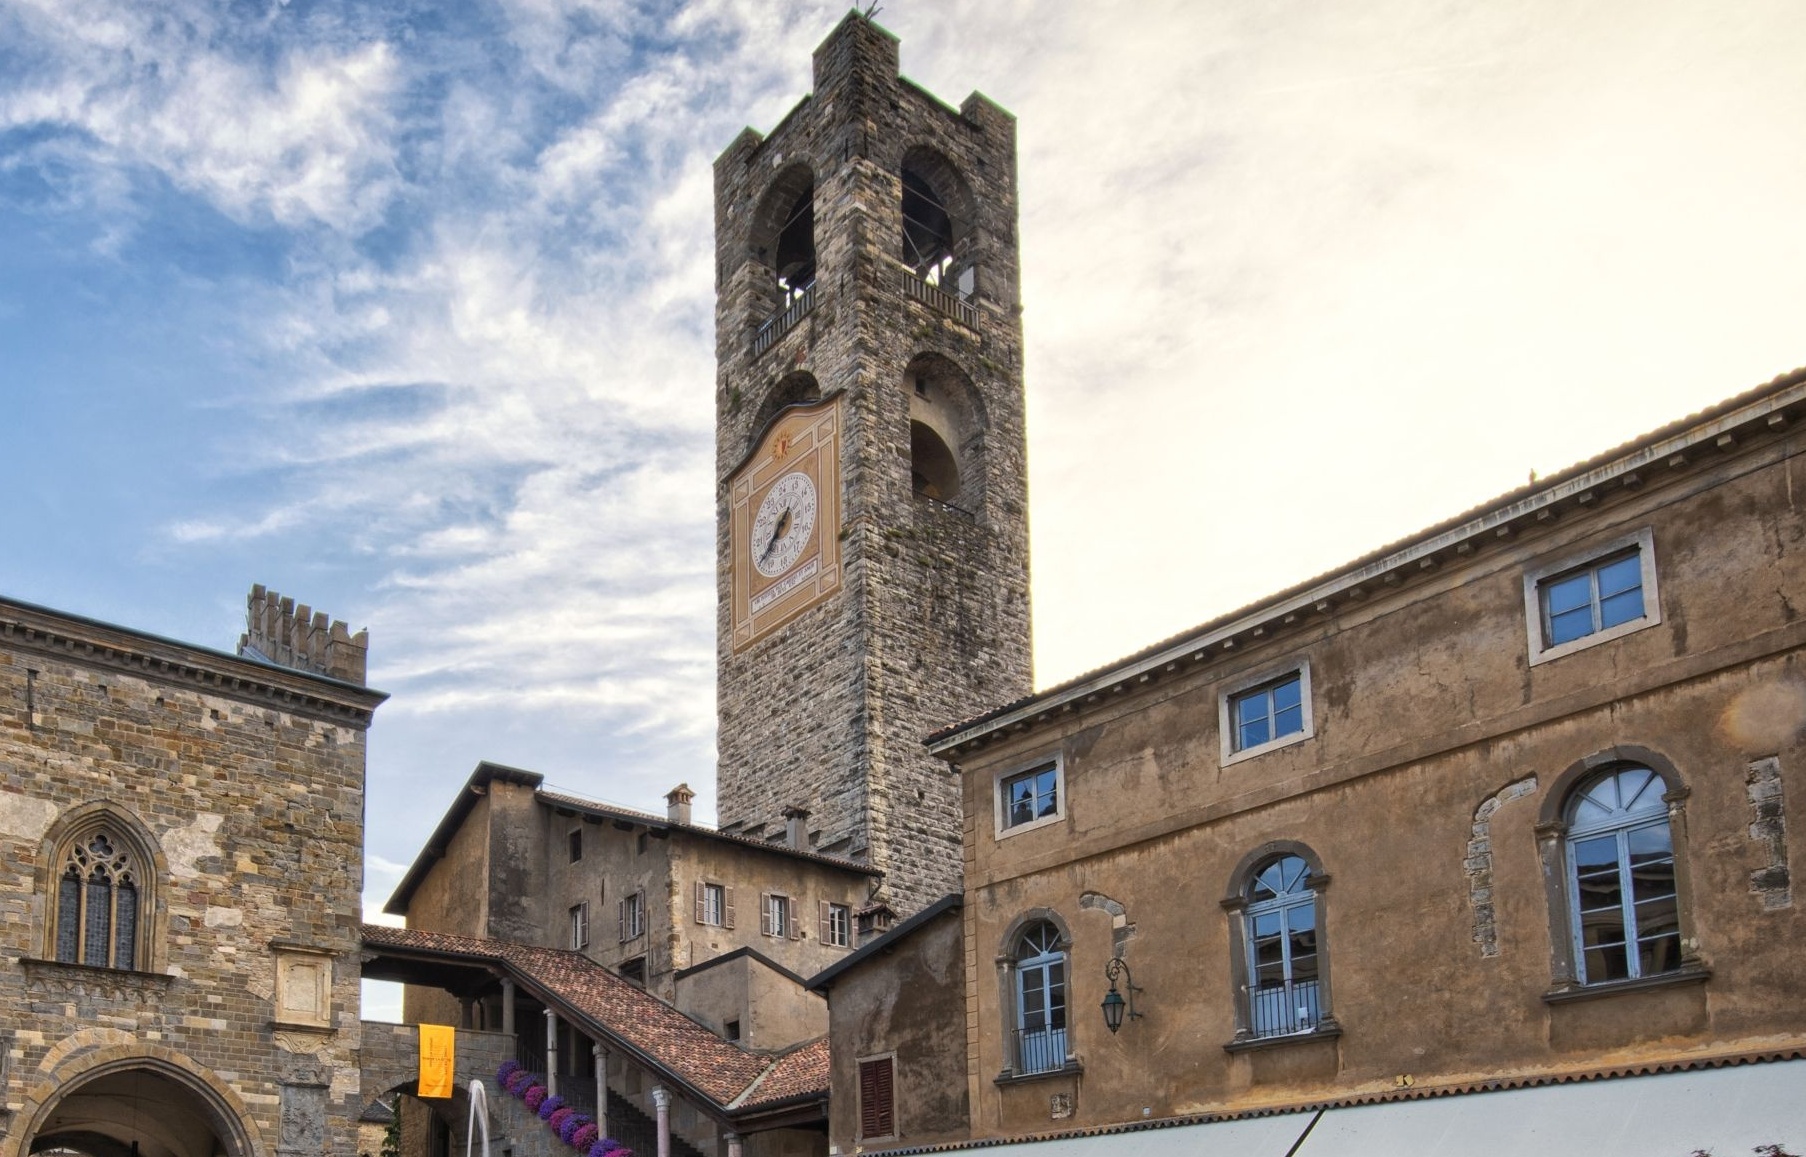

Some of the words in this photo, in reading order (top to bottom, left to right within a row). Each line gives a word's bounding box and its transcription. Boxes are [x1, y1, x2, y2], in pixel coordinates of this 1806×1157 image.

[792, 480, 799, 492] 13
[804, 502, 812, 514] 15
[755, 537, 763, 548] 21
[793, 541, 801, 553] 17
[780, 556, 788, 567] 18
